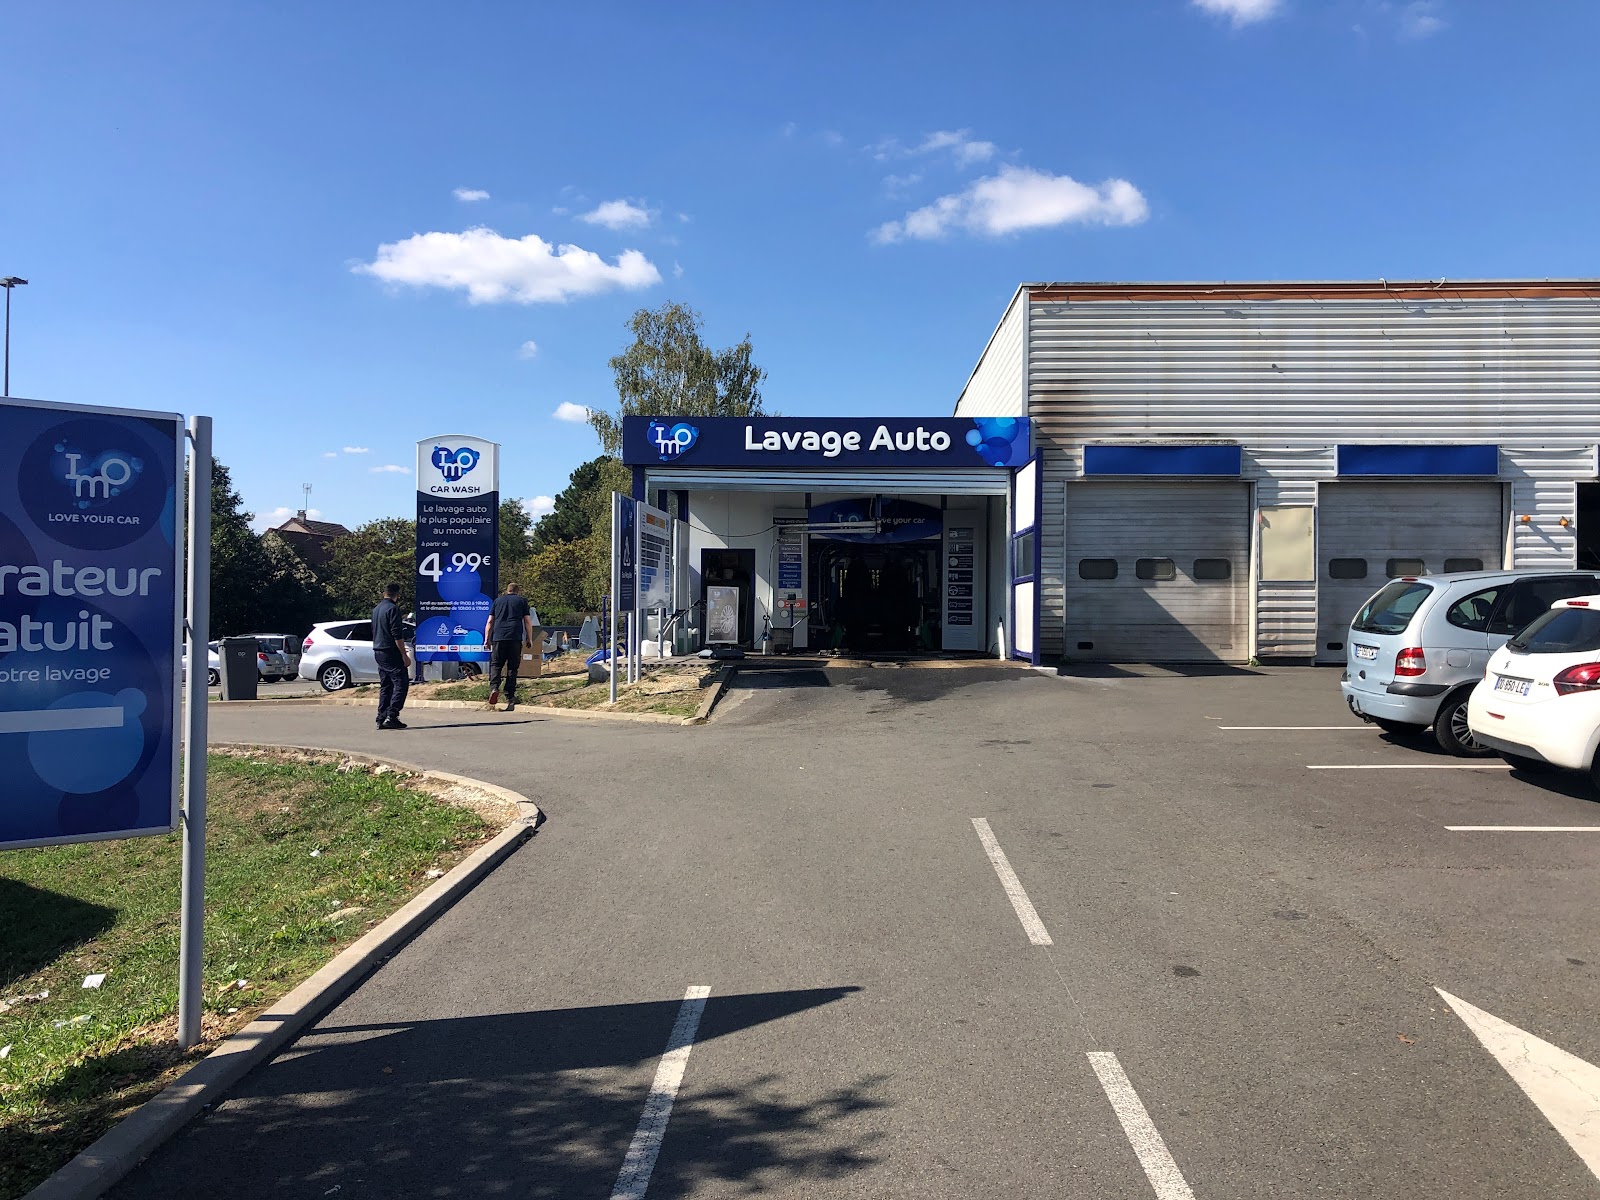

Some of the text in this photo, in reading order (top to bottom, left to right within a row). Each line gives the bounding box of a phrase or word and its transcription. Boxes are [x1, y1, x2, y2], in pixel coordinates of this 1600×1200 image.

[745, 425, 951, 458] Lavage Auto
[430, 485, 480, 494] CAR WASH
[423, 504, 488, 515] Le lavage auto
[48, 513, 140, 525] LOVE YOUR CAR
[419, 515, 492, 526] le plus populaire
[893, 517, 911, 526] your
[432, 526, 478, 535] au monde
[45, 665, 112, 684] lavage
